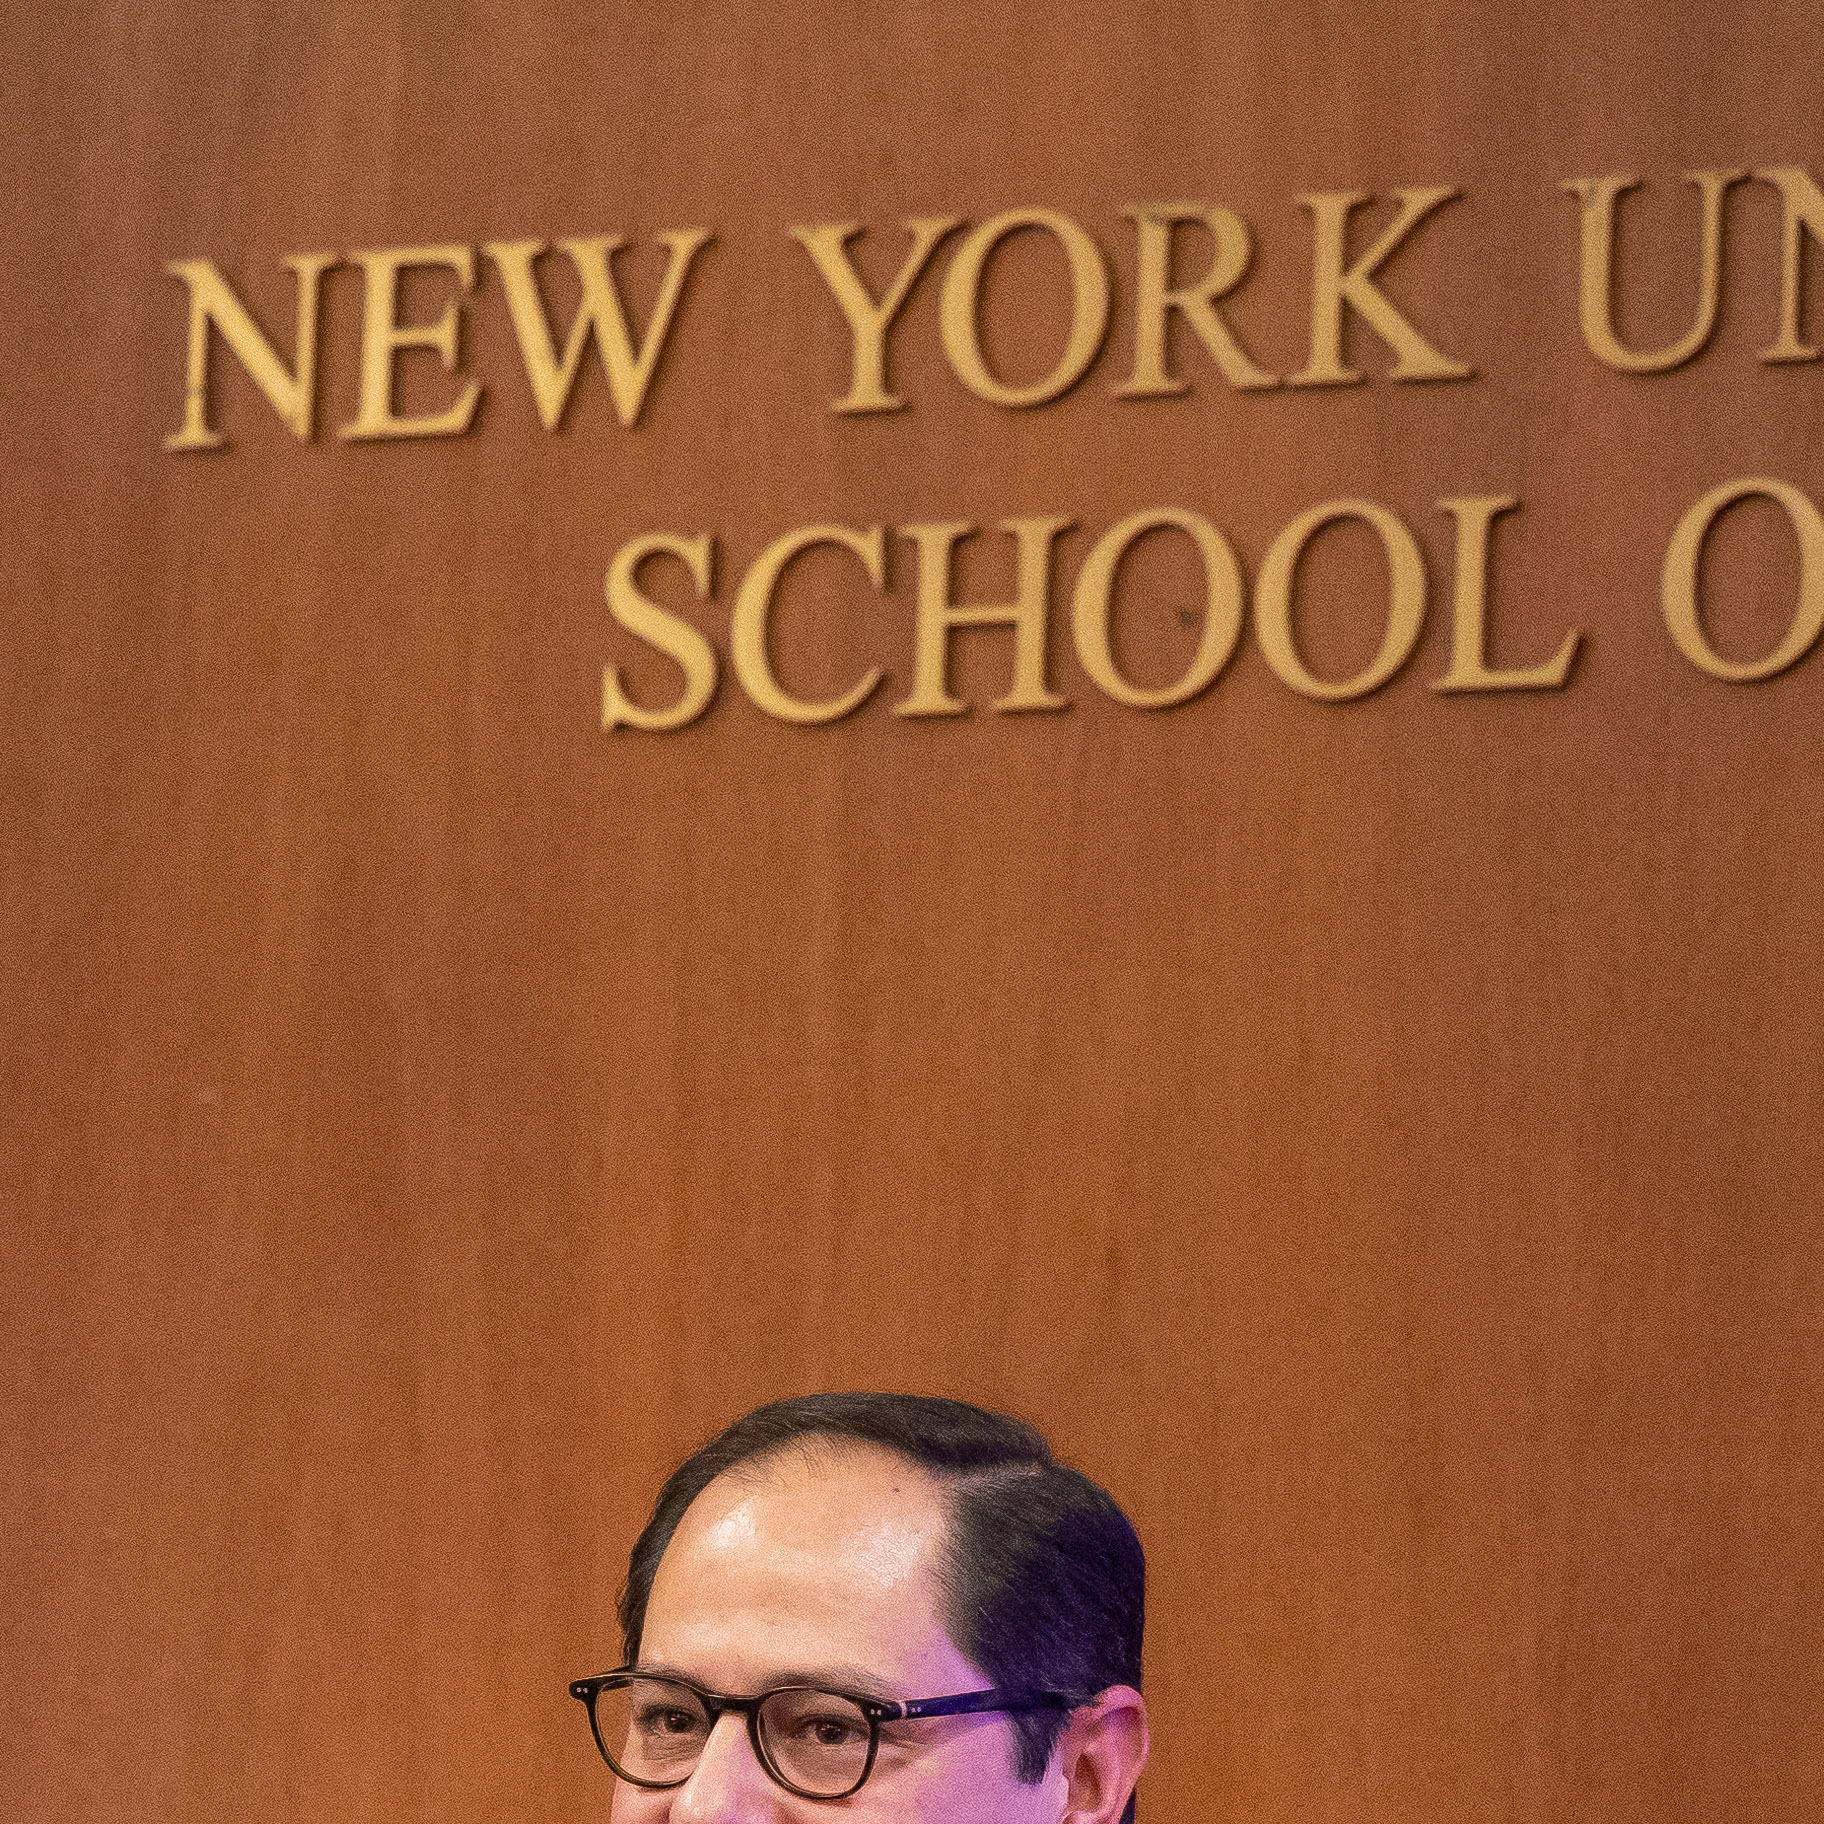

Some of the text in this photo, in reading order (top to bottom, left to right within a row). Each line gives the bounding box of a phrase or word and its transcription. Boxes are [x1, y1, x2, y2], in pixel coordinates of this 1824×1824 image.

[163, 226, 718, 454] NEW
[786, 184, 1476, 416] YORK
[598, 492, 1580, 735] SCHOOL
